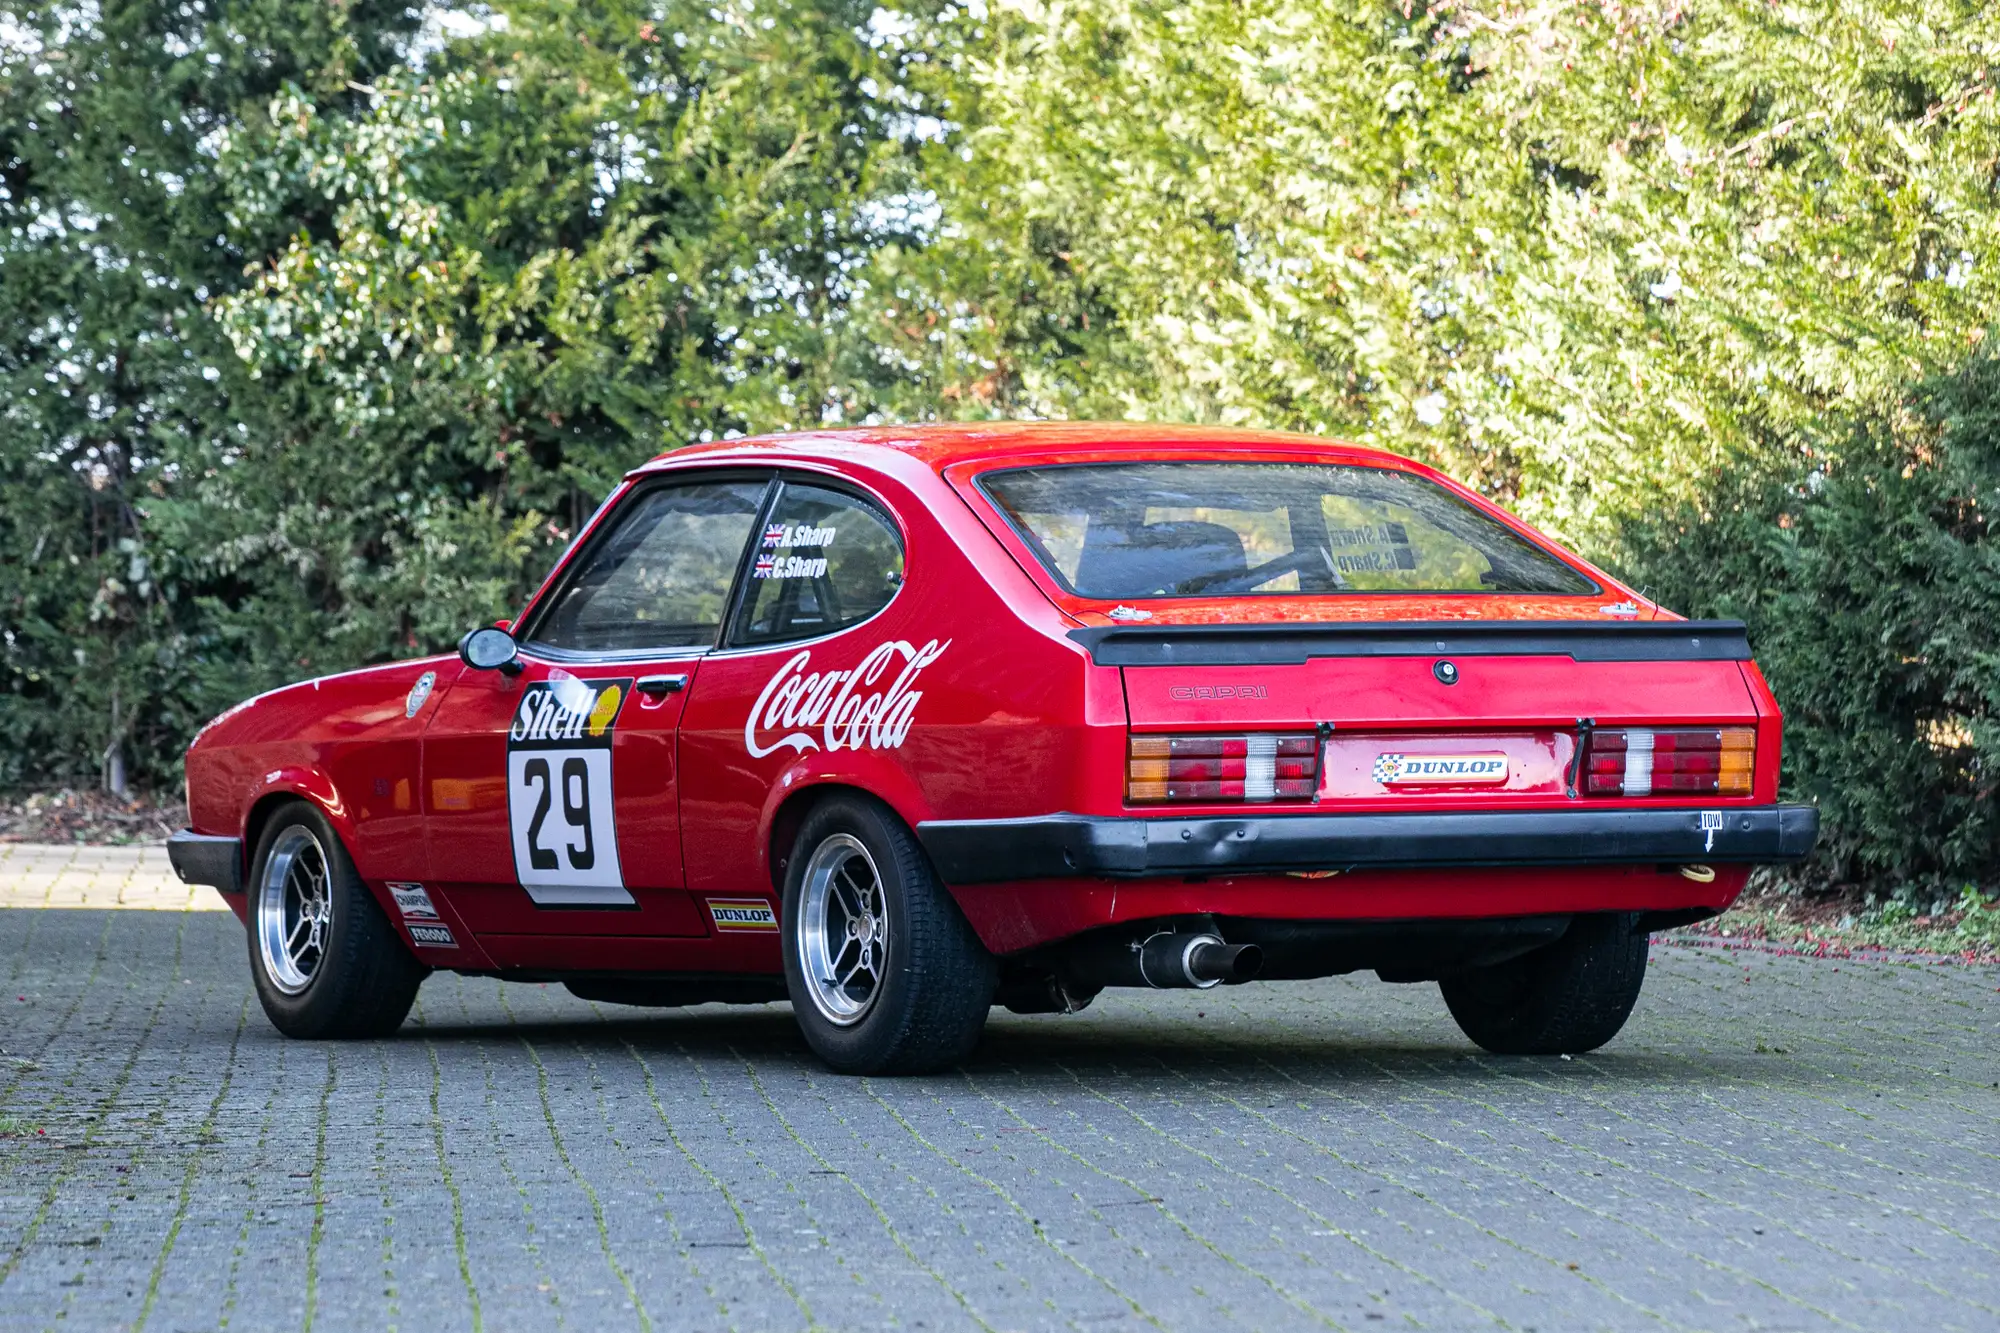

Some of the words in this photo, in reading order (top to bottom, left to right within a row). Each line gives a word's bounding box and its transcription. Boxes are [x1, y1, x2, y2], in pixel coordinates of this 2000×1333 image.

[780, 525, 836, 548] A.Sharp
[772, 556, 828, 579] C.Sharp
[745, 638, 952, 759] Coca-Cola
[1170, 685, 1268, 700] CAPRI
[510, 689, 597, 741] Shell
[1404, 761, 1502, 774] DUNLOP
[524, 757, 595, 870] 29
[1703, 813, 1720, 828] TOW
[712, 908, 771, 921] DUNLOP
[410, 927, 451, 942] FERODO
